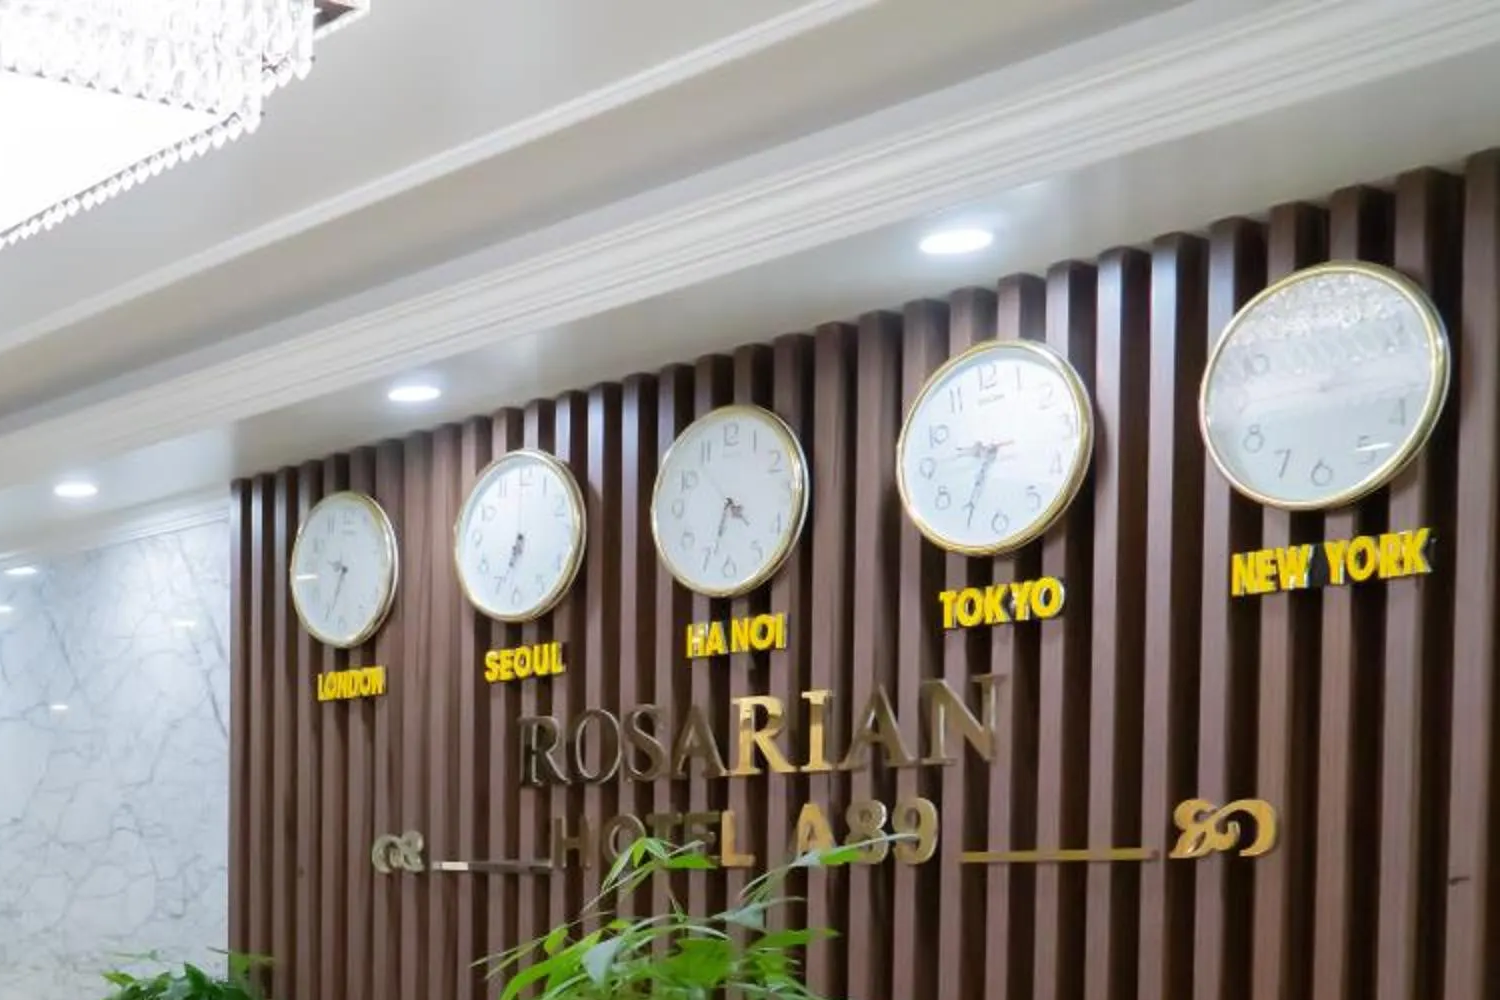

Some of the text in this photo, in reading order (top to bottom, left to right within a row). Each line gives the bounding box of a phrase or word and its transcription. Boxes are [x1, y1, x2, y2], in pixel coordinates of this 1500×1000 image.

[1242, 423, 1265, 454] 8
[1273, 447, 1292, 479] 7
[1310, 457, 1334, 487] 6
[1230, 527, 1433, 597] NEW YORK
[938, 574, 1066, 630] TOKYO
[316, 665, 387, 702] LONDON
[484, 641, 566, 684] SEOUL
[519, 673, 1005, 787] ROSARIAN
[550, 797, 939, 869] HOTEL A89
